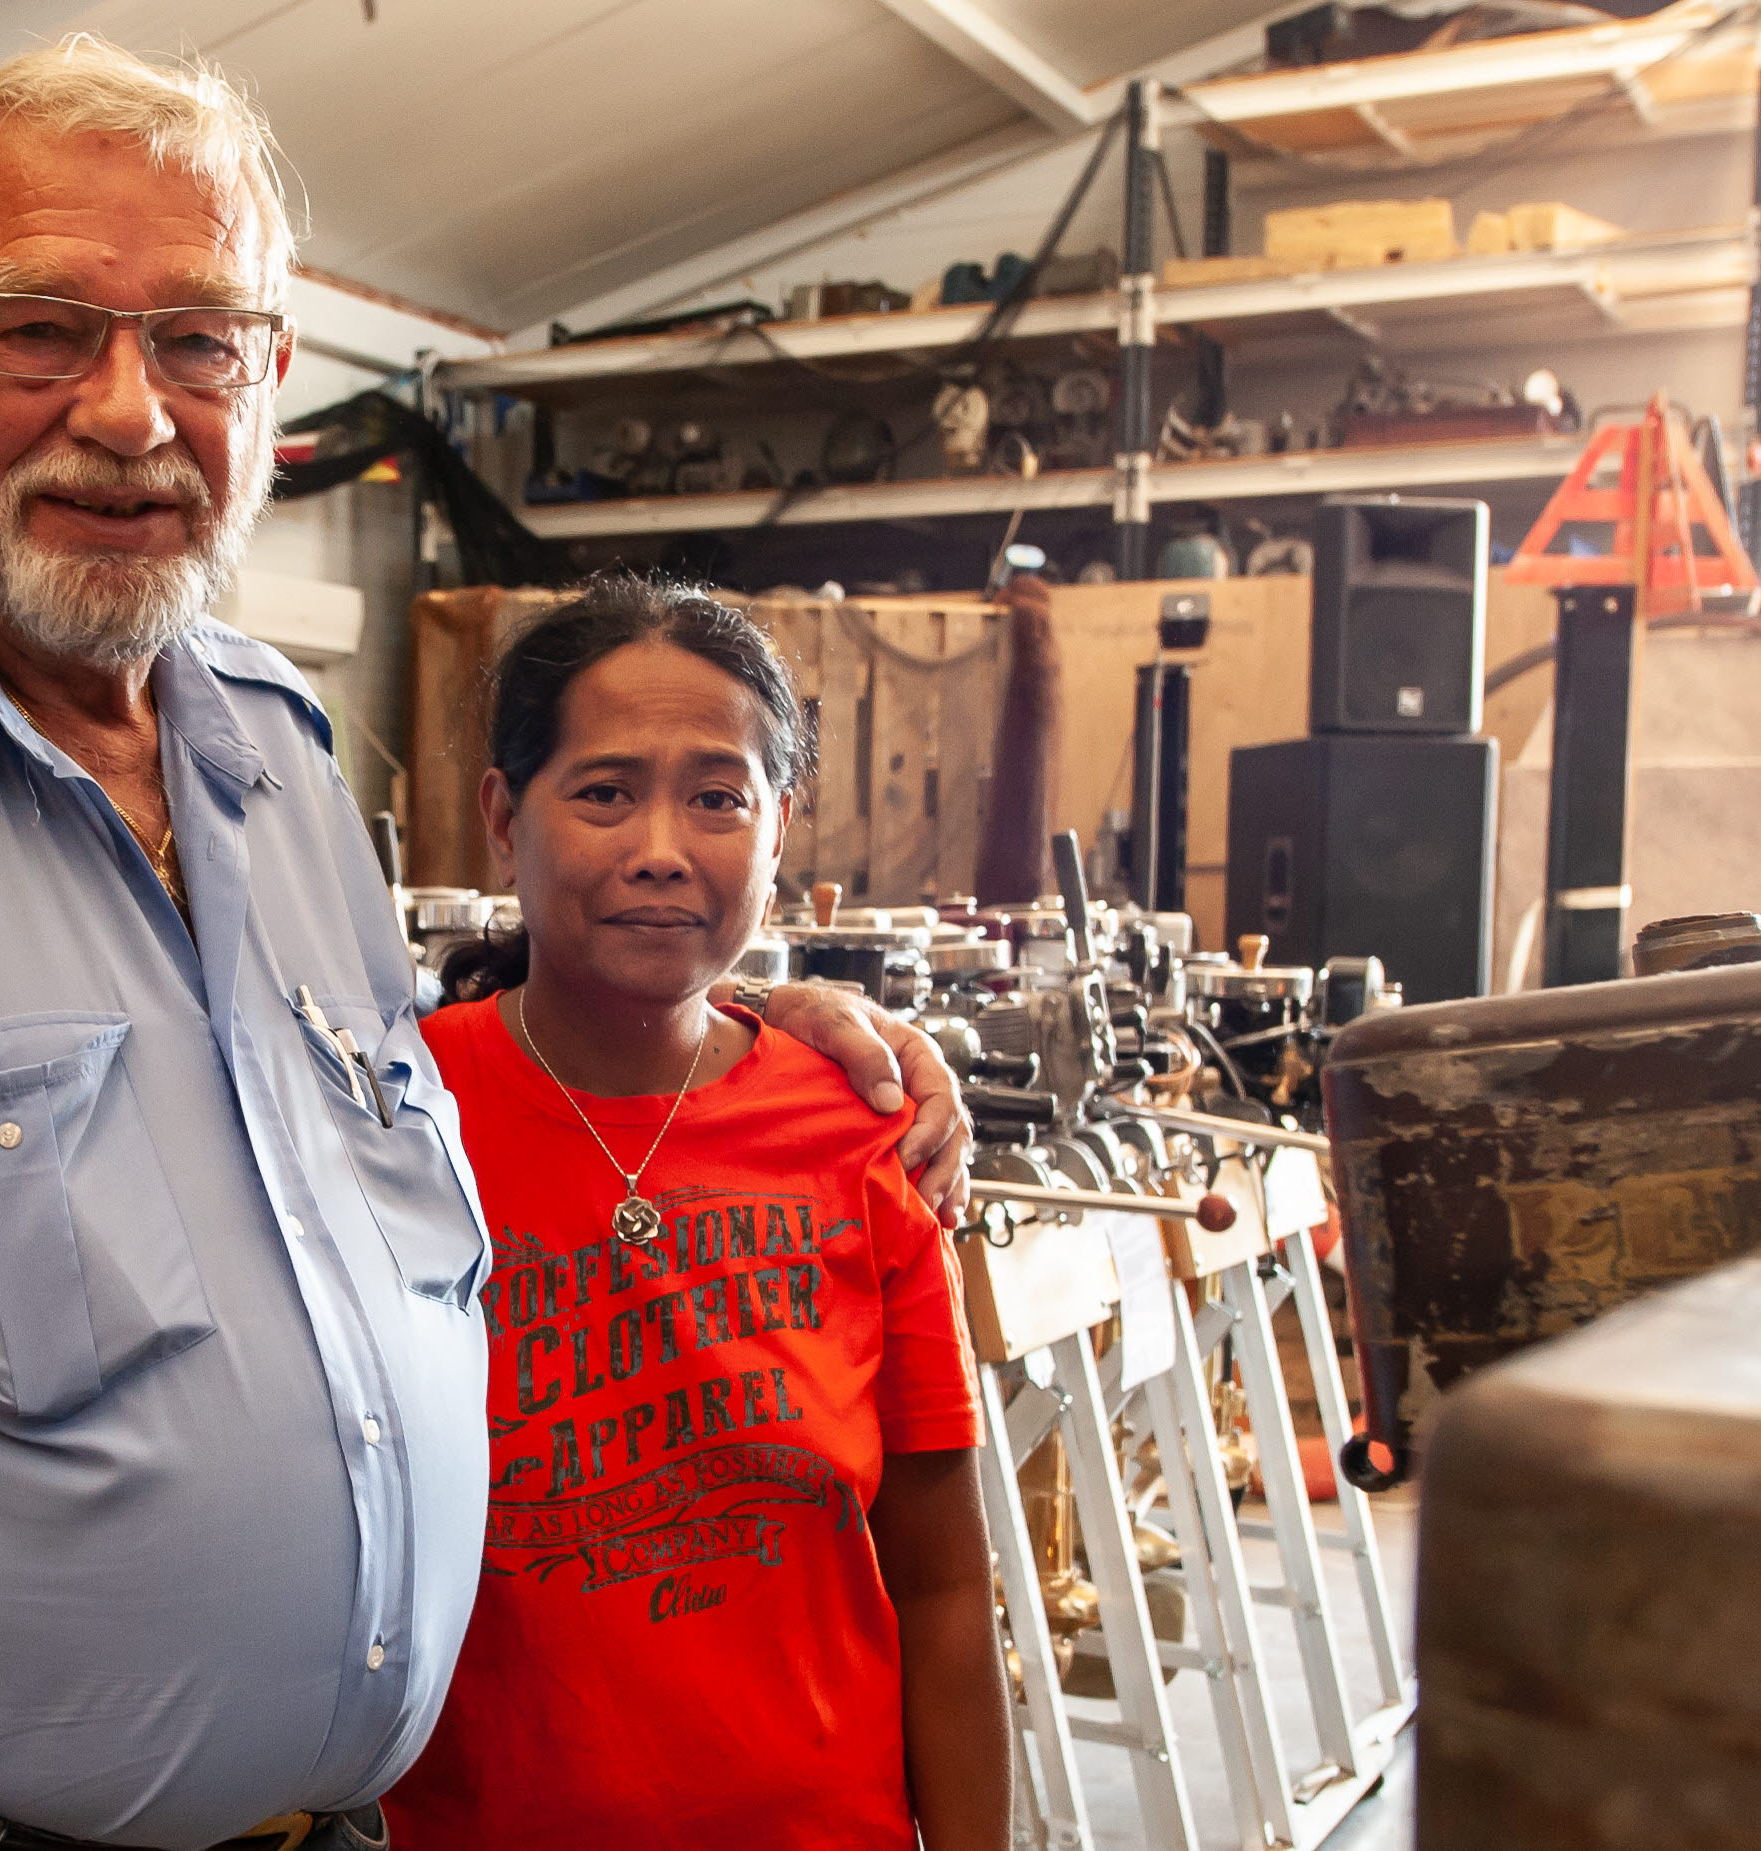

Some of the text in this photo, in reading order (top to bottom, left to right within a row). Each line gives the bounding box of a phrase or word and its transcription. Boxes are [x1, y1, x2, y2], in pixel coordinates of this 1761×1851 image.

[477, 1203, 823, 1337] ROFFESIONAL
[484, 1449, 826, 1541] AR AS LONG AS POSSIBLE
